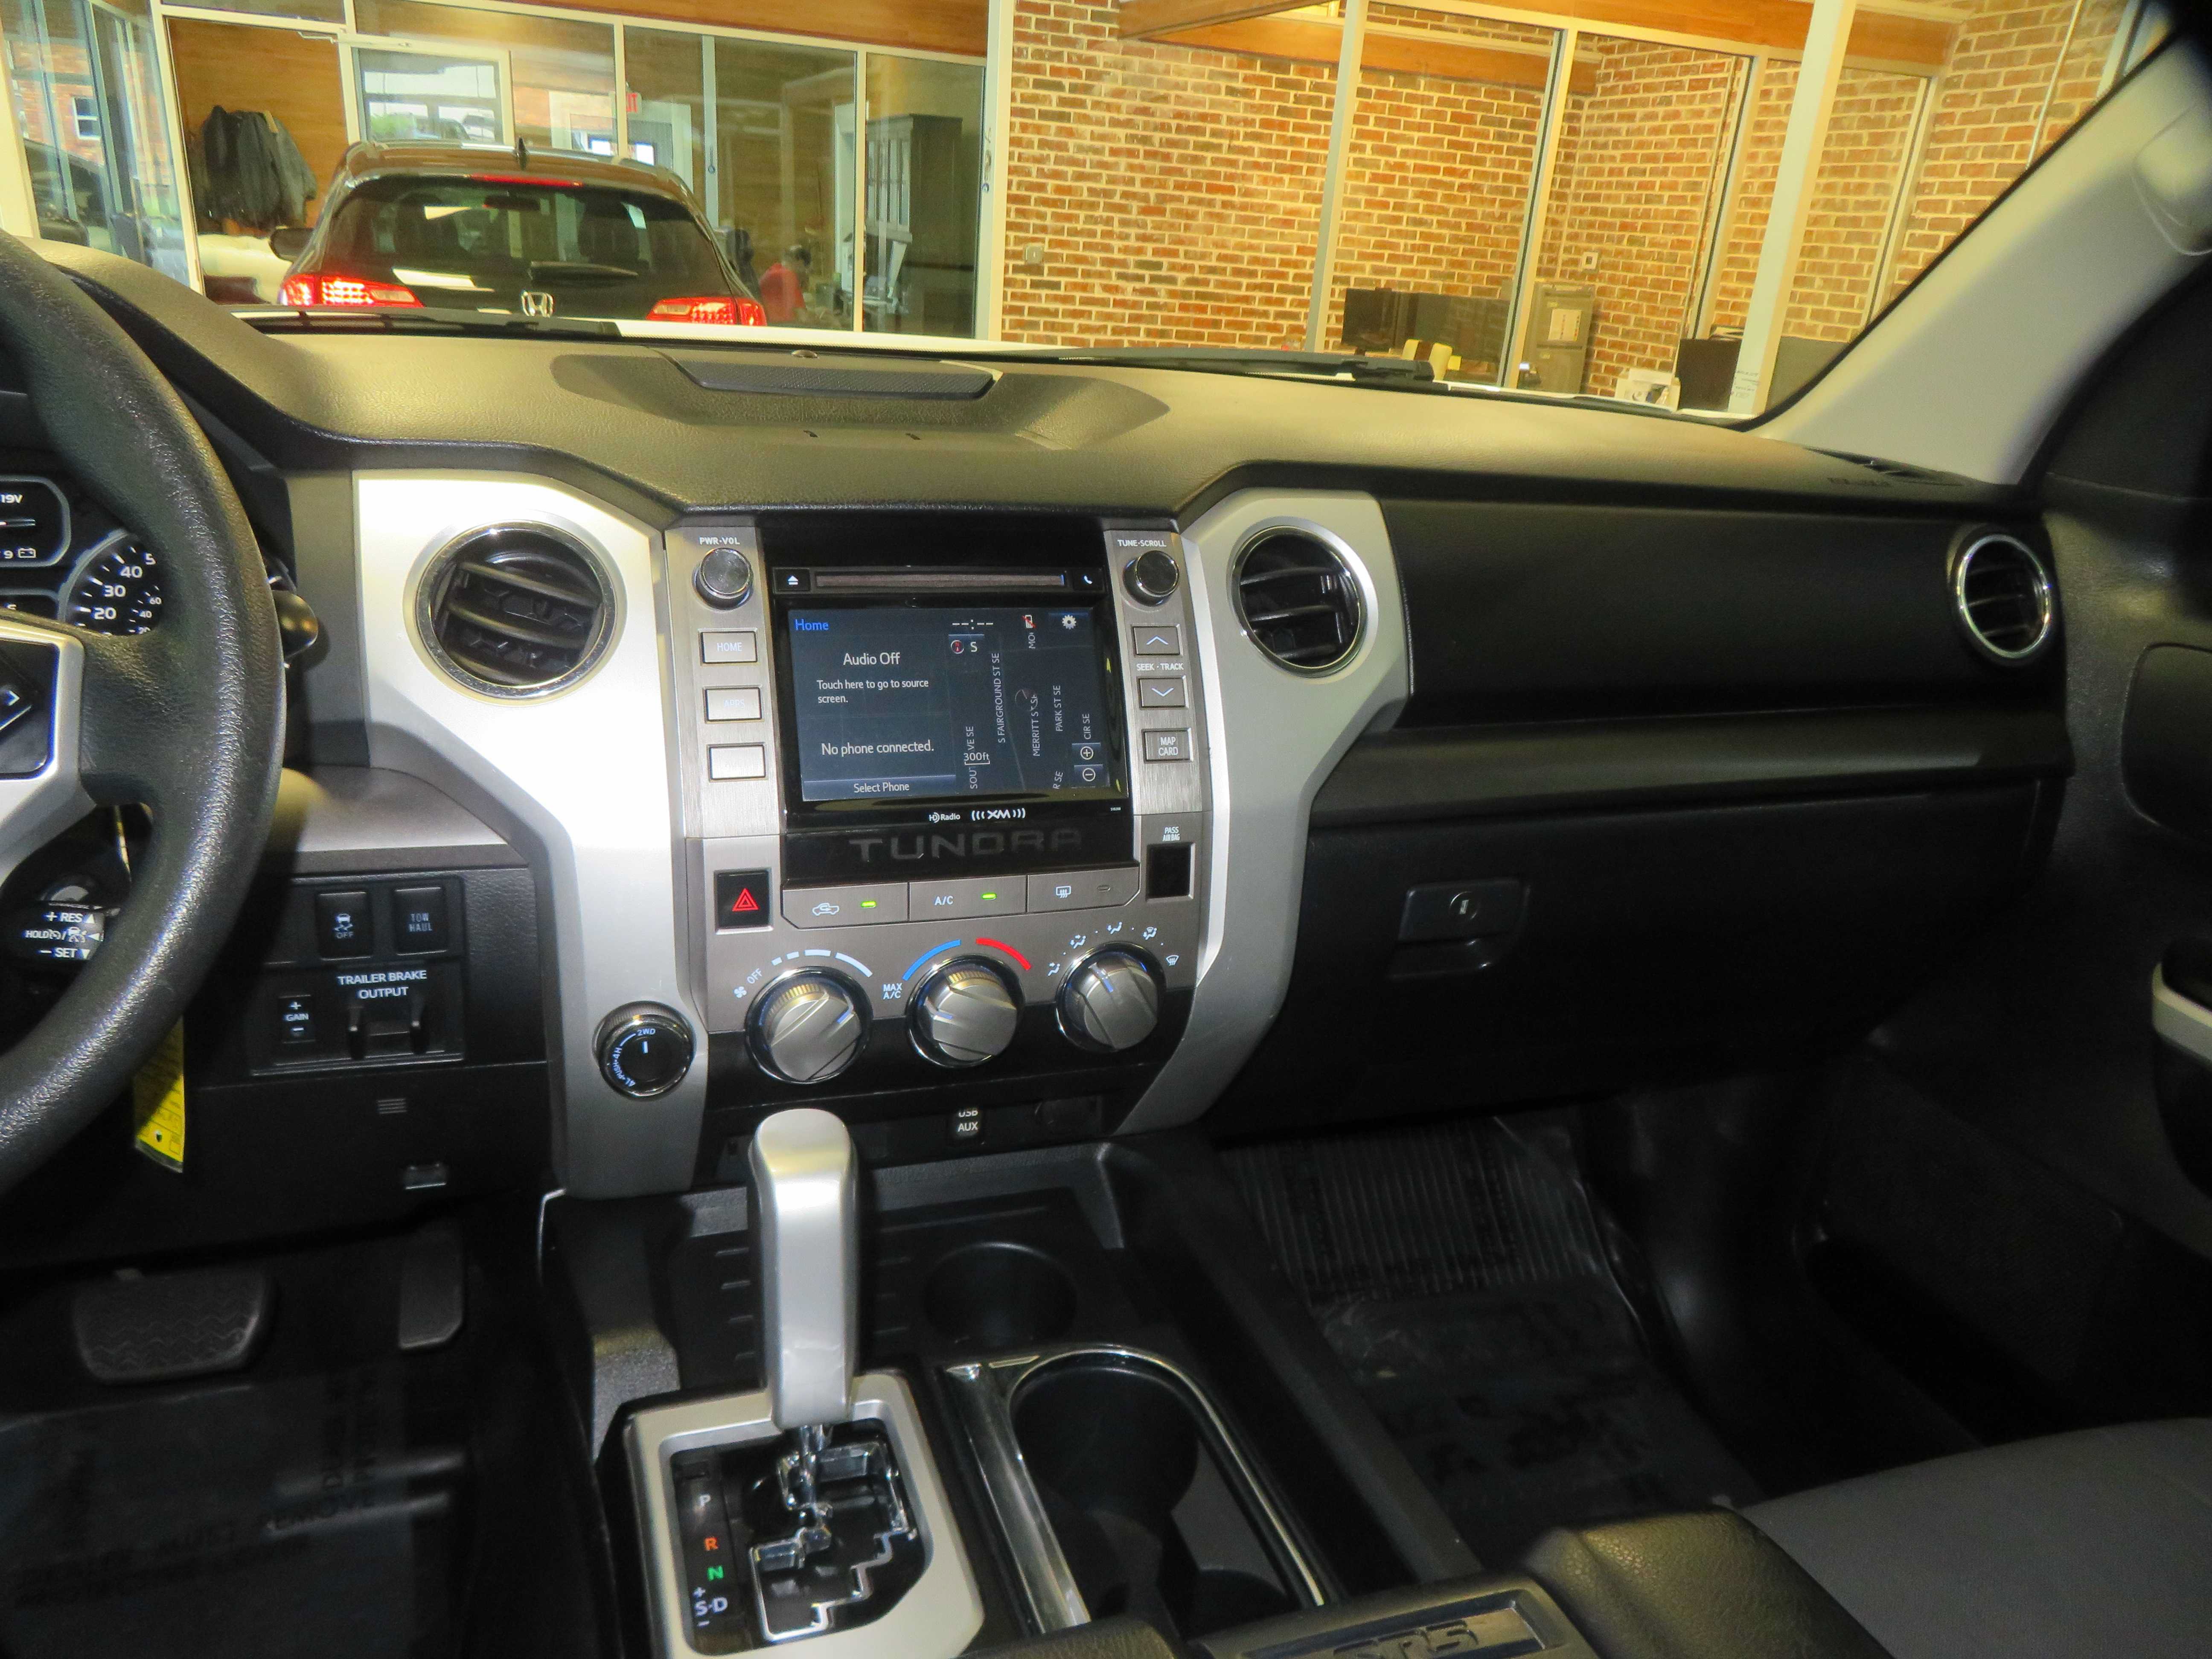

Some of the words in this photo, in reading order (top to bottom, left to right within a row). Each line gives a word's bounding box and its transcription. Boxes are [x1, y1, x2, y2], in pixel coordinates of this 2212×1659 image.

[120, 566, 143, 578] 40
[104, 585, 125, 597] 30
[93, 608, 116, 619] 20
[795, 619, 829, 631] Home
[1028, 632, 1036, 649] MO
[717, 642, 742, 652] HOME
[970, 641, 978, 652] S
[843, 653, 877, 665] Audio
[879, 652, 900, 665] Off
[991, 653, 1000, 664] SE
[993, 665, 1001, 677] ST
[817, 680, 843, 690] Touch
[845, 679, 864, 689] here
[867, 680, 875, 689] to
[878, 681, 888, 690] go
[891, 680, 900, 688] to
[902, 679, 929, 688] source
[1053, 685, 1061, 696] SE
[818, 695, 848, 704] screen.
[1054, 698, 1062, 708] ST
[994, 678, 1005, 736] FAIRGROUND
[1055, 710, 1063, 732] PARK
[1082, 713, 1090, 723] SE
[966, 726, 974, 736] SE
[1083, 725, 1091, 740] CIR
[1031, 719, 1040, 757] MERRITT
[1160, 736, 1176, 746] MAP
[821, 743, 838, 755] No
[841, 742, 874, 757] phone
[876, 739, 934, 754] connected.
[967, 739, 975, 751] VE
[963, 752, 990, 761] 300ft
[1158, 747, 1179, 757] CARD
[969, 767, 978, 789] SOU
[1055, 771, 1064, 782] SE
[854, 783, 880, 793] Select
[883, 781, 910, 792] Phone
[1164, 826, 1179, 834] PASS
[848, 829, 1081, 862] TUNDRA
[934, 895, 954, 905] A/C
[60, 912, 83, 923] RES
[410, 912, 429, 923] TOW
[409, 923, 433, 932] HAUL
[25, 930, 49, 939] HOLD
[54, 947, 78, 958] SET
[338, 973, 386, 985] TRAILER
[389, 969, 427, 982] BRAKE
[747, 968, 763, 984] OFF
[358, 987, 409, 999] OUTPUT
[883, 983, 903, 992] MAX
[883, 990, 901, 1000] A/C
[285, 1013, 309, 1022] GAIN
[637, 1028, 656, 1036] 2WD
[958, 1121, 978, 1132] AUX
[699, 1494, 711, 1508] P
[705, 1537, 719, 1551] R
[707, 1566, 724, 1581] N
